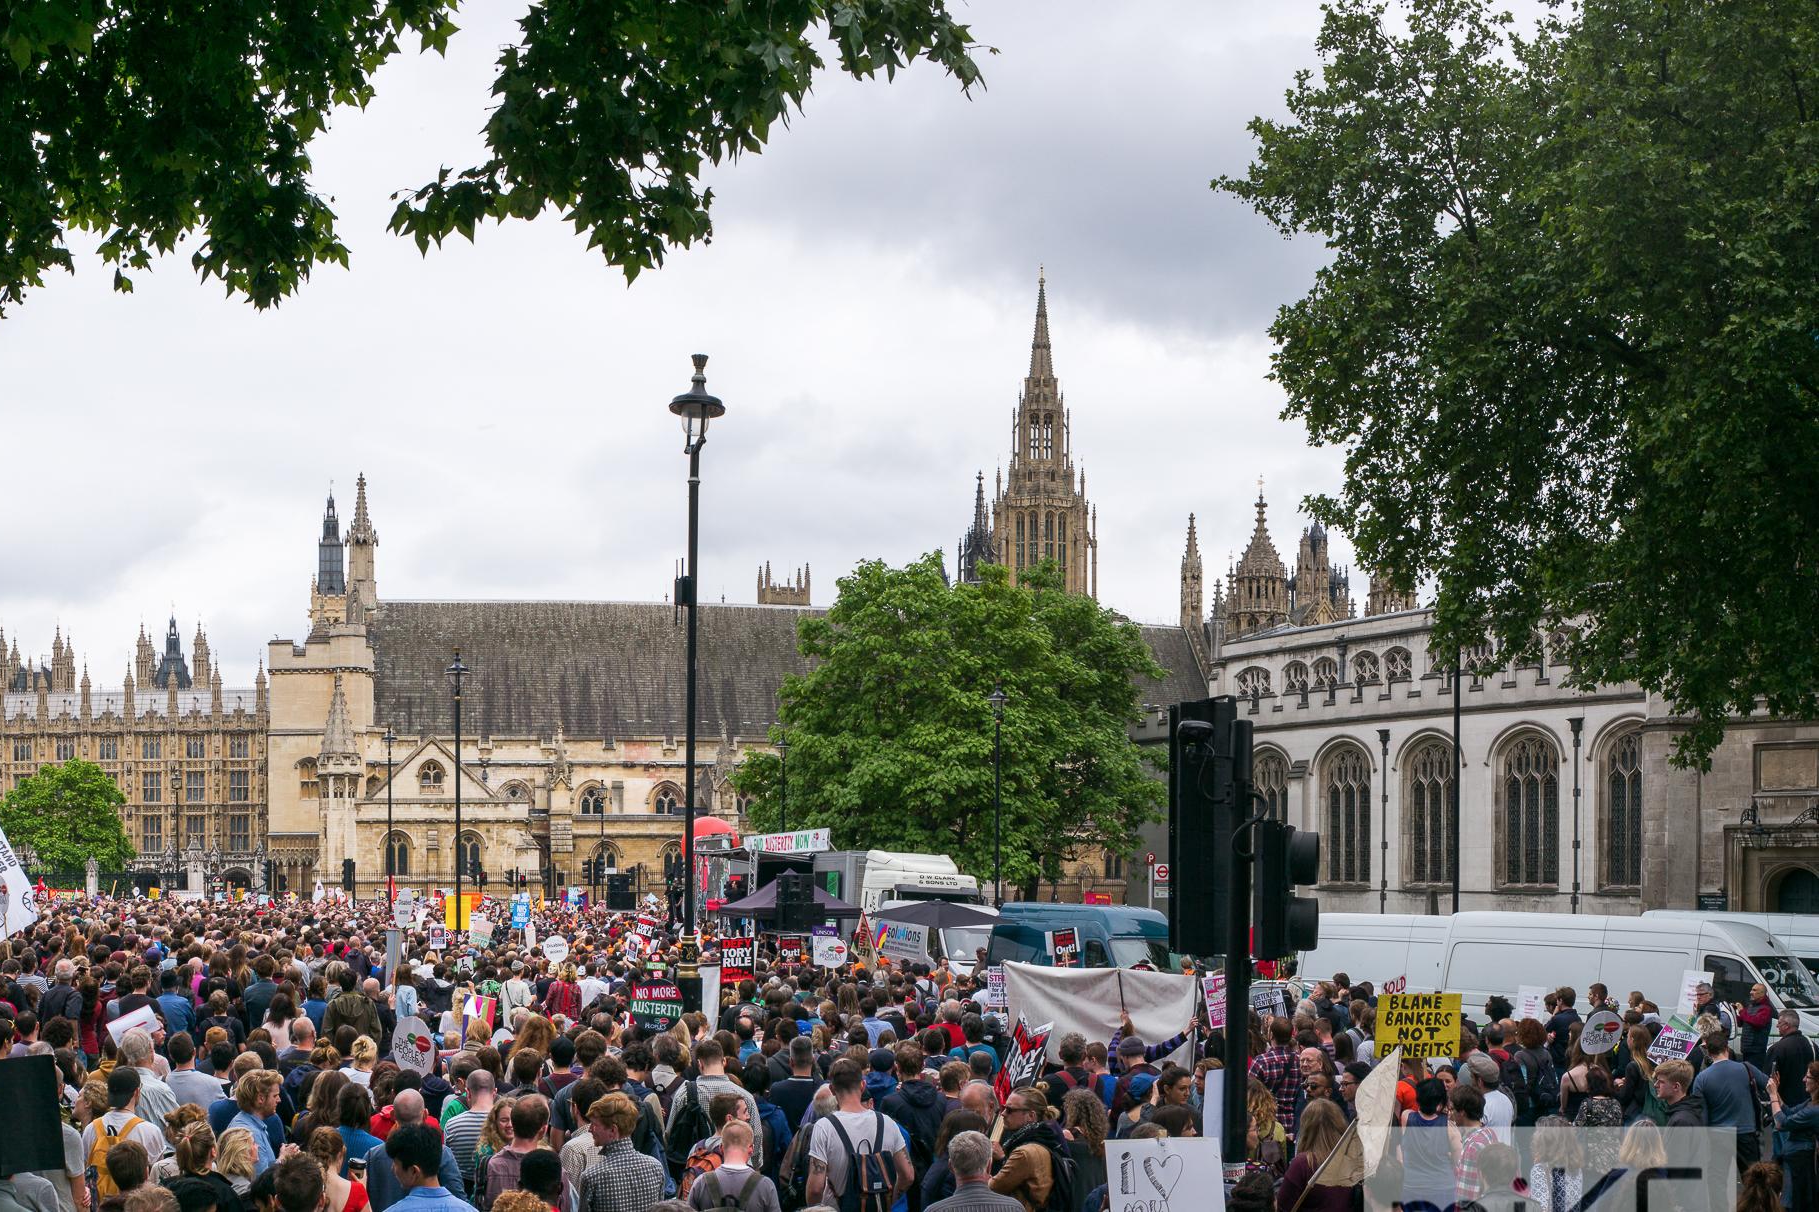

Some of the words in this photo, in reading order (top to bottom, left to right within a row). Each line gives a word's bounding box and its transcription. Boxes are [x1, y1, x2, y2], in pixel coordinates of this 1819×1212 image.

[765, 835, 794, 851] AUSTERITY
[796, 834, 810, 848] NOW
[723, 938, 752, 948] DEFY
[1056, 943, 1075, 955] Out!
[722, 948, 752, 958] TORY
[782, 948, 800, 956] Out!
[722, 957, 752, 967] RULE
[635, 988, 648, 999] NO
[652, 987, 676, 998] MORE
[1389, 994, 1442, 1010] BLAME
[632, 1001, 683, 1017] AUSTERITY
[1385, 1011, 1453, 1027] BANKERS
[1398, 1027, 1441, 1041] NOT
[1673, 1030, 1692, 1040] Youth
[398, 1037, 409, 1046] THE
[1659, 1036, 1682, 1050] Fight
[395, 1043, 425, 1062] PEOPLE'S
[1651, 1048, 1685, 1058] AUSTERITY
[1120, 1152, 1136, 1194] i
